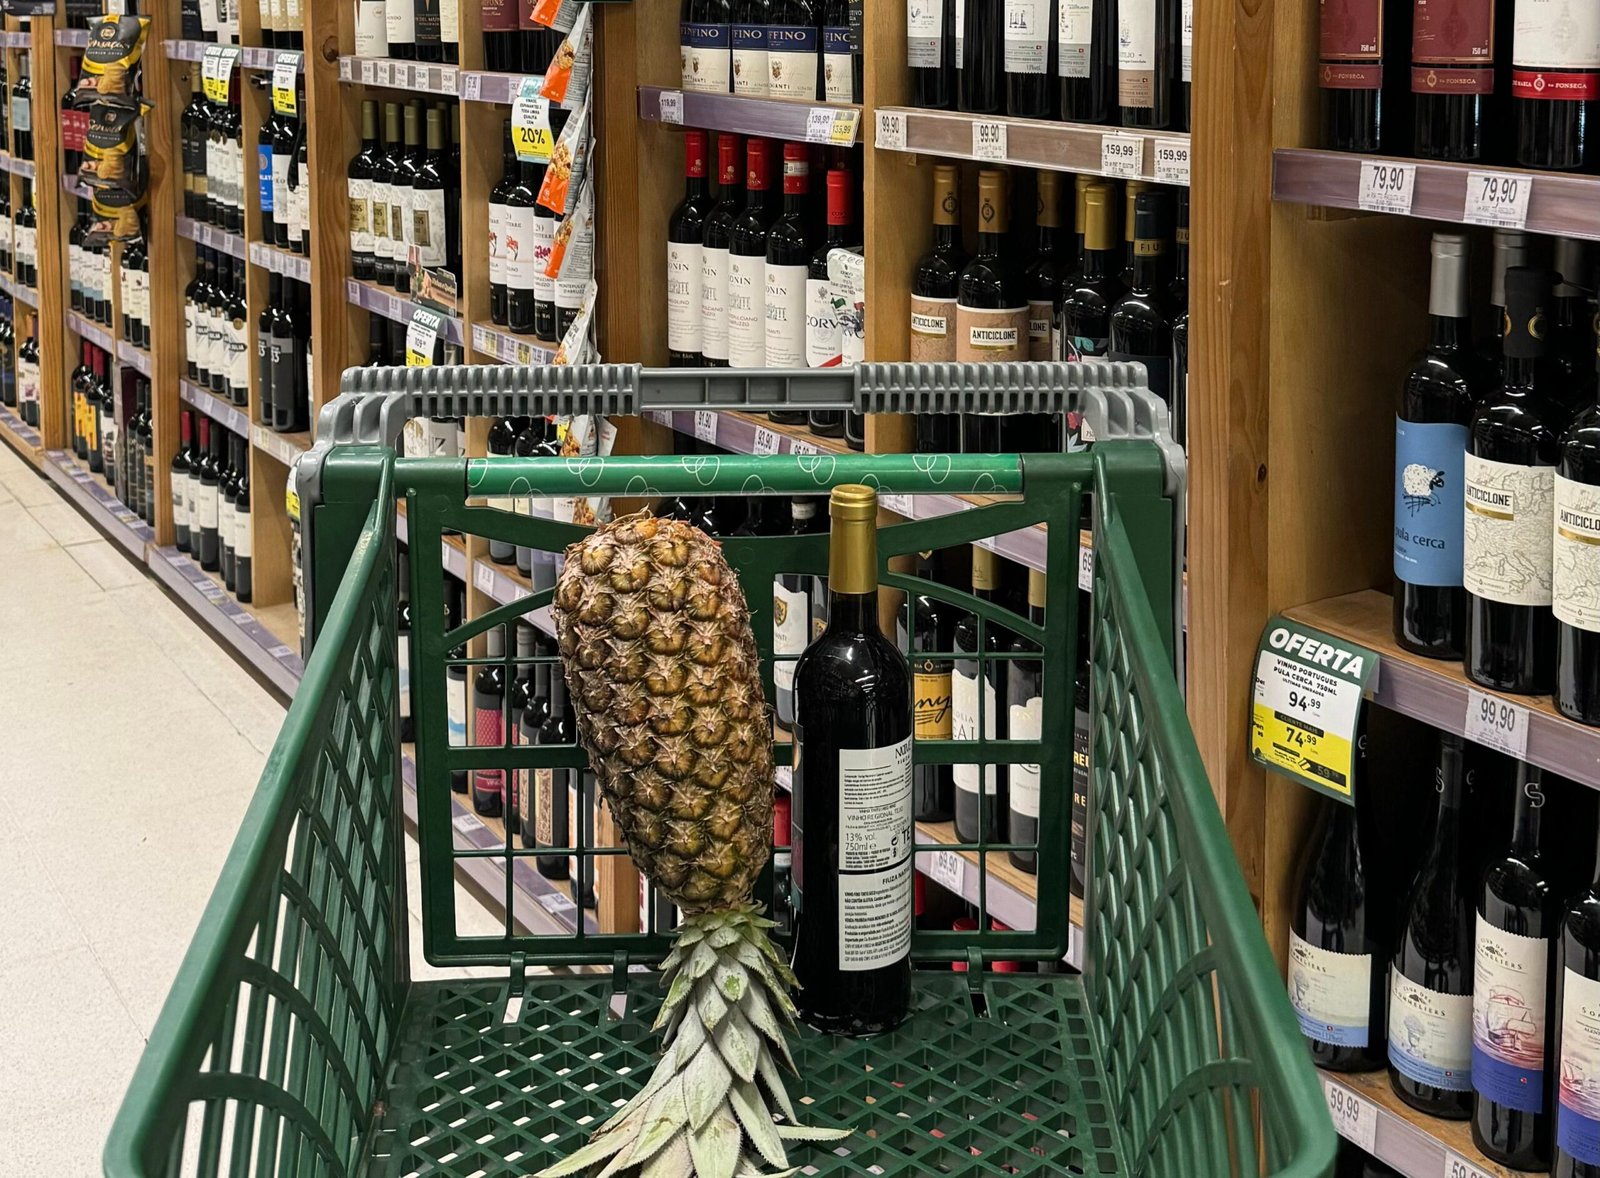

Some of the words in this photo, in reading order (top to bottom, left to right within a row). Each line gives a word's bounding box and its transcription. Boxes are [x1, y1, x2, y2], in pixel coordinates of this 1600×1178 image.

[520, 127, 545, 144] 20%
[1106, 144, 1134, 158] 159,99
[1158, 149, 1188, 163] 159,99
[1373, 166, 1404, 196] 79,90
[1481, 177, 1518, 208] 79,90
[413, 309, 440, 330] OFERTA
[972, 330, 1016, 341] ANTICICLONE
[1413, 534, 1445, 549] cerca
[1269, 628, 1364, 679] OFERTA
[1273, 666, 1290, 678] PULA
[1291, 674, 1313, 686] CERCA
[1316, 683, 1337, 696] 750ML
[1277, 659, 1297, 671] VINHO
[1298, 667, 1338, 687] PORTUGUES
[1480, 698, 1515, 732] 99,90
[845, 842, 868, 851] 750ml
[846, 833, 863, 842] 13%
[1330, 1087, 1360, 1122] 59,99
